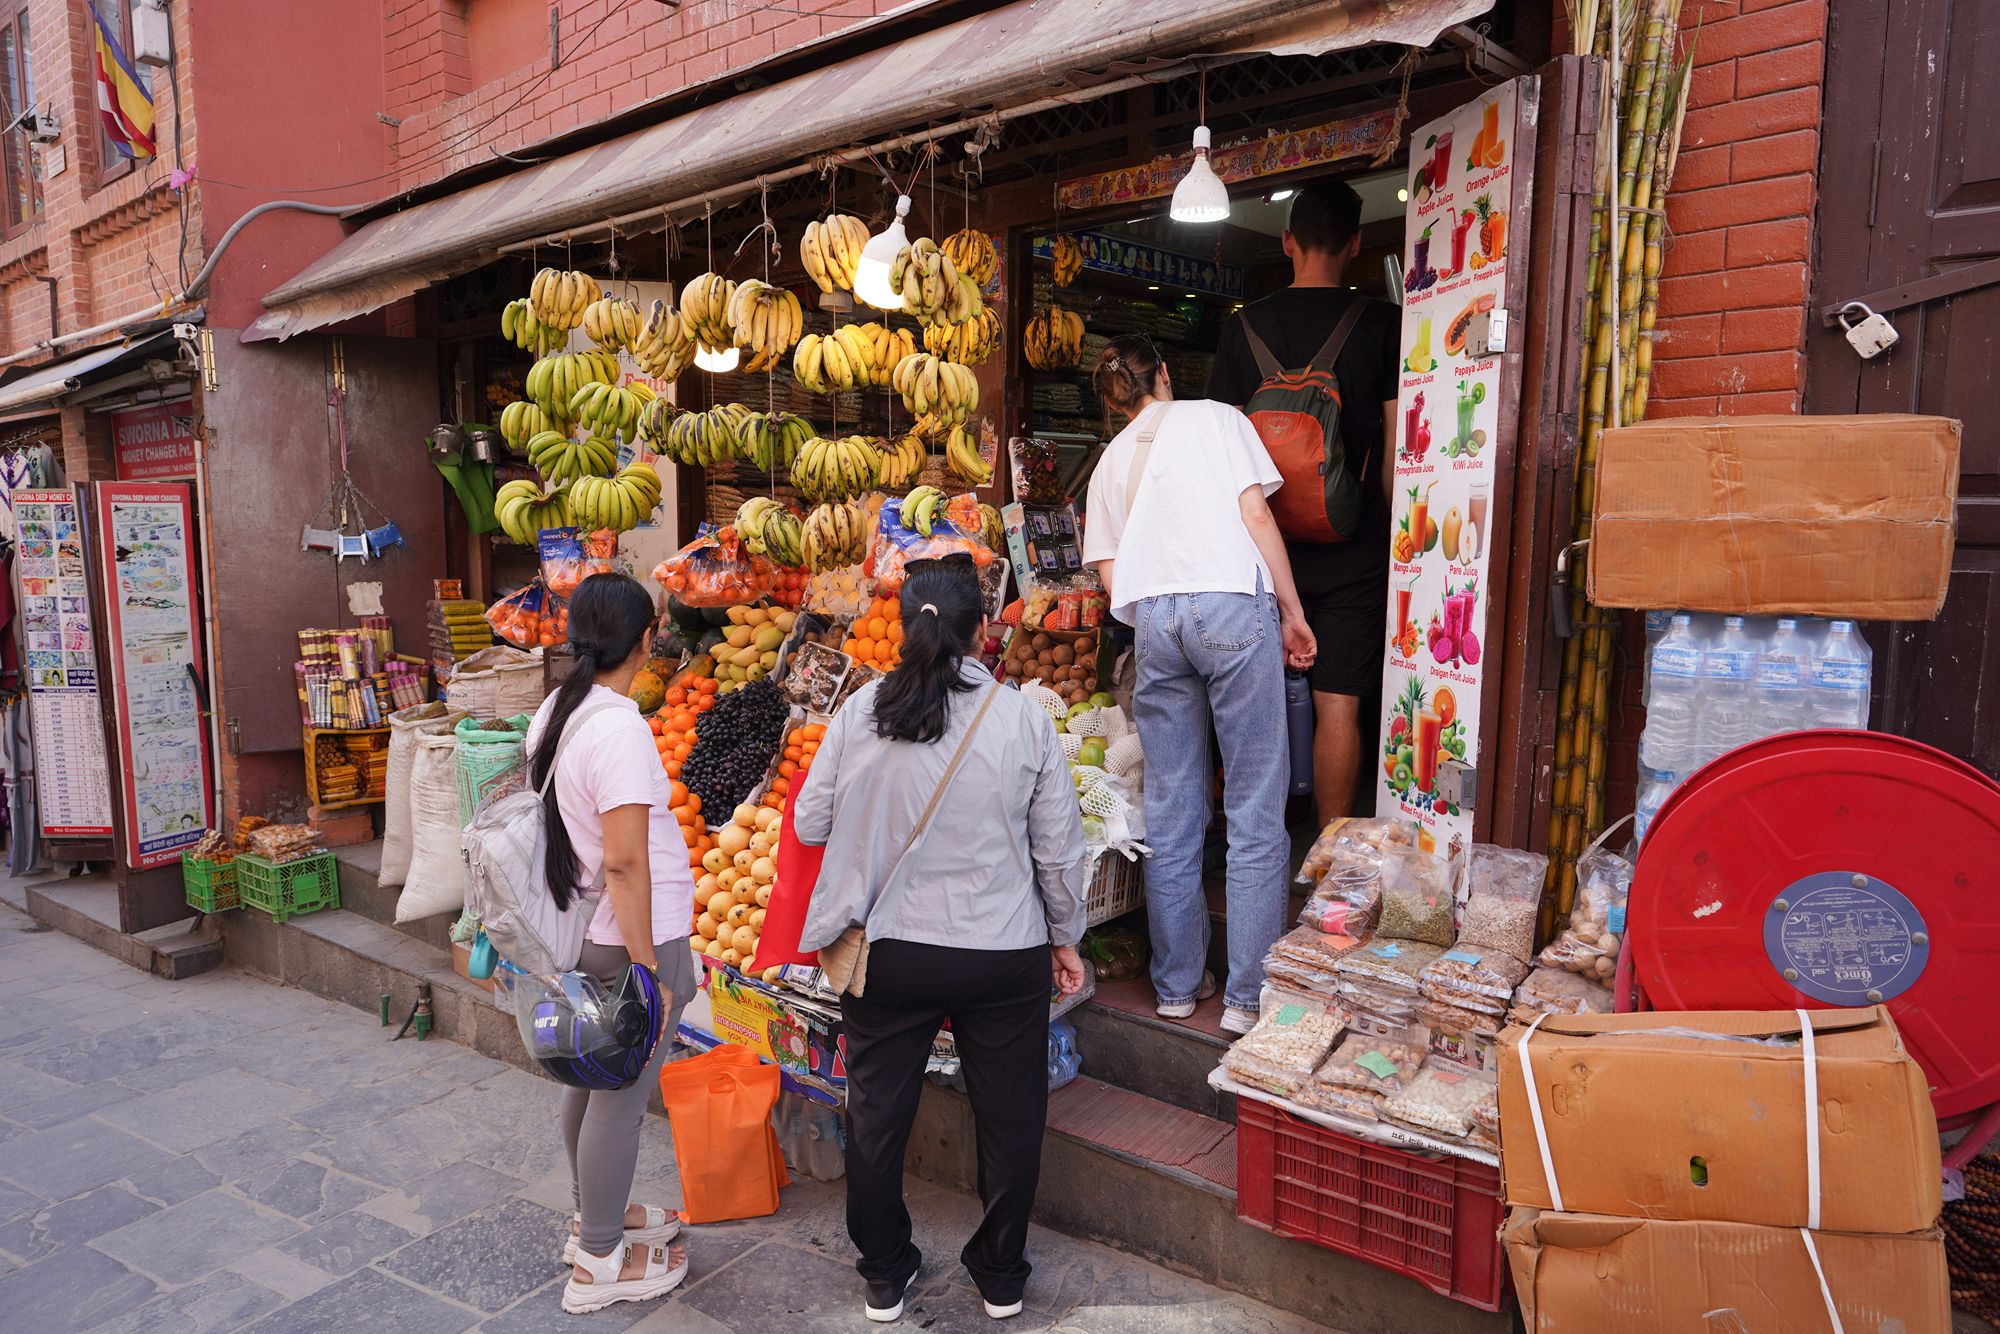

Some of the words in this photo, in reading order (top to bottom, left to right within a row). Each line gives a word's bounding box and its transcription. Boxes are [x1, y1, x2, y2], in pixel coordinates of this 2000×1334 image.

[1466, 174, 1490, 192] Orange
[1491, 165, 1510, 181] Juice
[1417, 200, 1436, 218] Apple
[1436, 192, 1454, 208] Juice
[1474, 270, 1493, 282] Pineapple
[1494, 265, 1504, 276] Juice
[1436, 283, 1459, 296] Watermelon
[1459, 278, 1470, 288] Juice
[1406, 294, 1420, 306] Grapes
[1422, 290, 1432, 300] Juice
[1454, 364, 1475, 377] Papaya
[1477, 360, 1493, 371] Juice
[1404, 376, 1421, 388] Mosambi
[1422, 374, 1434, 384] Juice
[118, 420, 170, 446] SWORNA
[122, 448, 144, 464] MONEY
[145, 445, 177, 461] CHANGER
[179, 442, 192, 457] Pvt.
[1396, 466, 1422, 476] Pomegranate
[1423, 464, 1434, 473] Juice
[1467, 460, 1483, 469] Juice
[14, 493, 35, 502] SWORNA
[50, 493, 65, 501] MONEY
[1394, 563, 1408, 574] Mango
[1410, 564, 1422, 573] Juice
[1450, 565, 1462, 575] Pare
[1463, 566, 1478, 576] Juice
[1390, 656, 1404, 667] Carrot
[1404, 660, 1416, 671] Juice
[1430, 666, 1449, 679] Draigan
[1450, 671, 1461, 680] Fruit
[1462, 673, 1476, 684] Juice
[1400, 802, 1412, 815] Mixed
[1413, 808, 1422, 820] Fruit
[1424, 814, 1436, 827] Juice
[754, 1001, 773, 1015] NHAT
[714, 1013, 734, 1030] FRUIT
[734, 1022, 761, 1043] DRAGON
